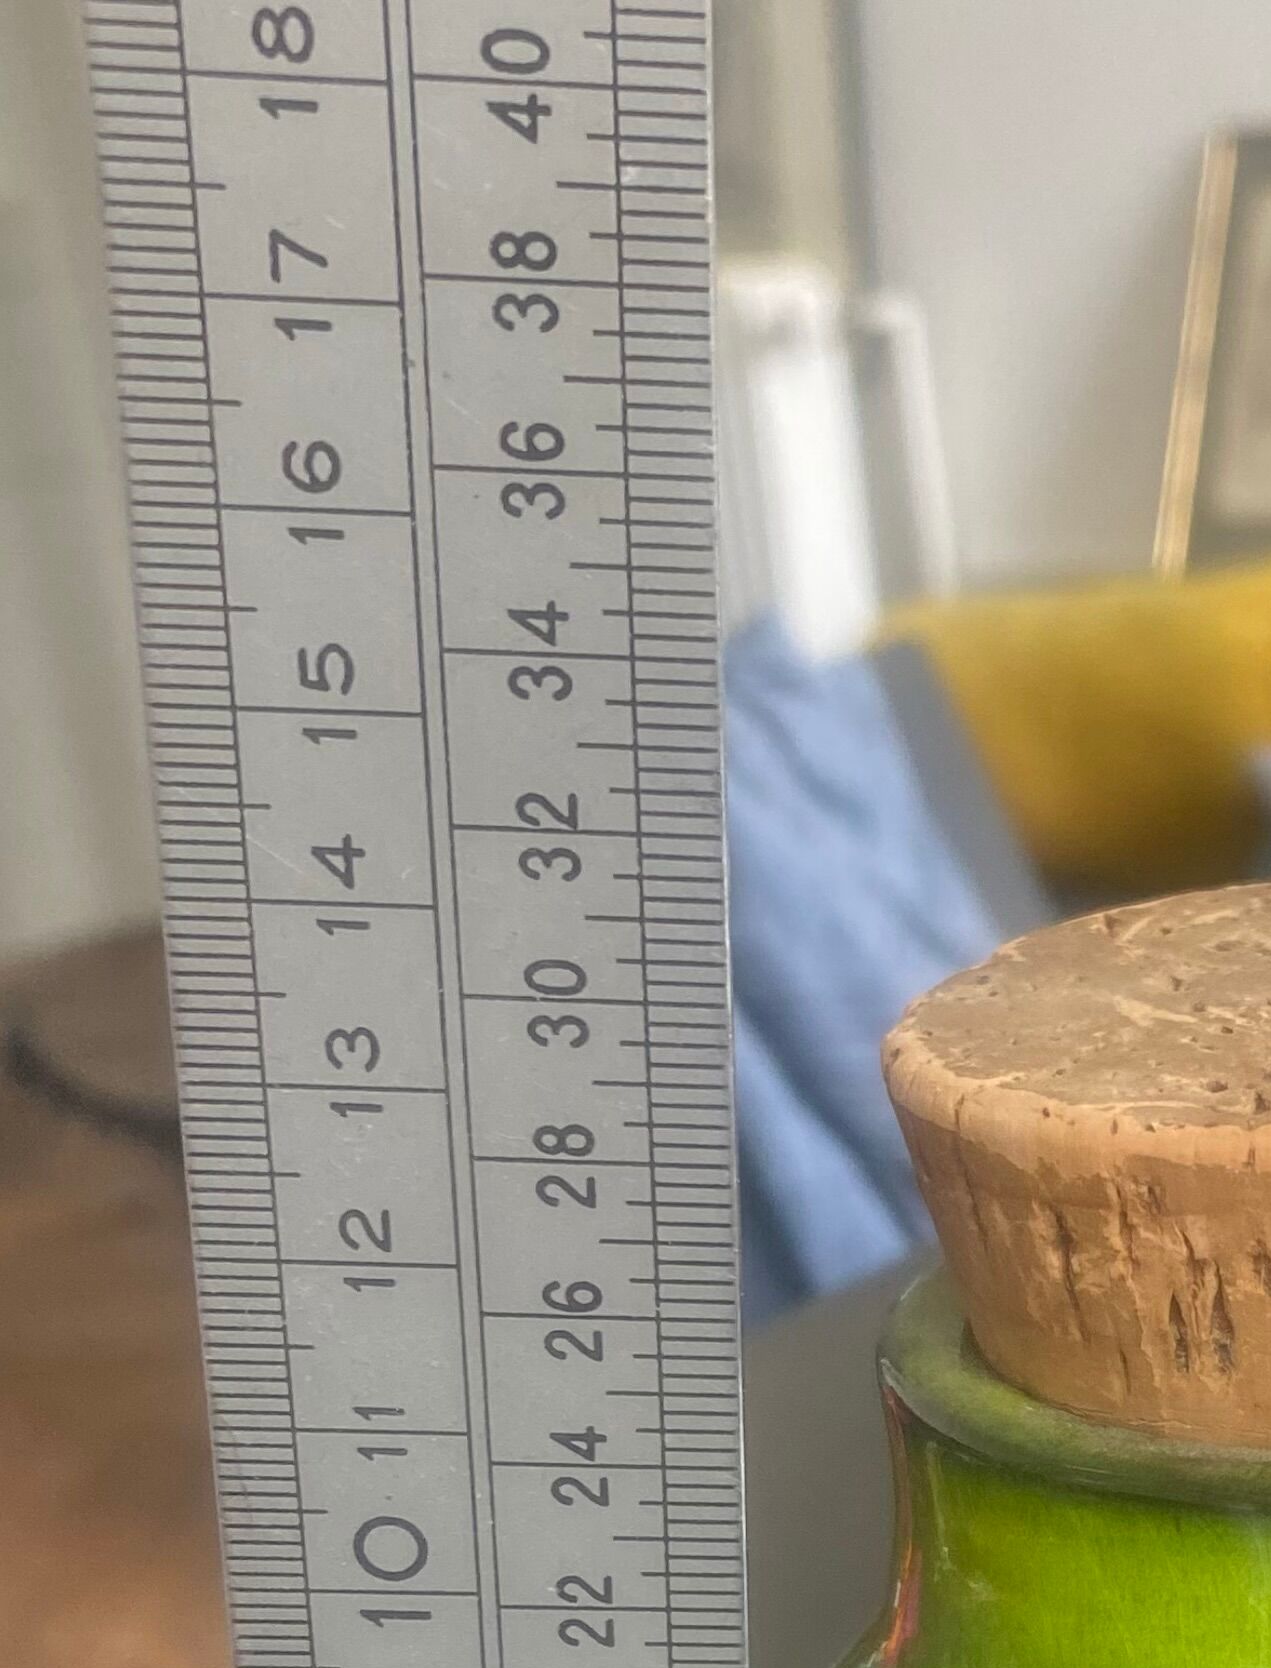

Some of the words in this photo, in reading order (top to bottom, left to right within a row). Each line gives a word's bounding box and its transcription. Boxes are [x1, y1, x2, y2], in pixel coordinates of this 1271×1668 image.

[251, 6, 318, 120] 18
[480, 27, 552, 143] 40
[269, 228, 332, 340] 17
[489, 230, 560, 333] 38
[282, 440, 345, 544] 16
[499, 421, 566, 520] 36
[298, 643, 357, 744] 15
[507, 600, 573, 699] 34
[311, 834, 371, 936] 14
[515, 792, 582, 882] 32
[523, 959, 590, 1048] 30
[325, 1026, 383, 1117] 13
[532, 1124, 597, 1209] 28
[338, 1208, 396, 1292] 12
[542, 1280, 604, 1361] 26
[352, 1406, 408, 1461] 11
[550, 1425, 610, 1507] 24
[353, 1515, 432, 1628] 10
[555, 1575, 615, 1648] 22
